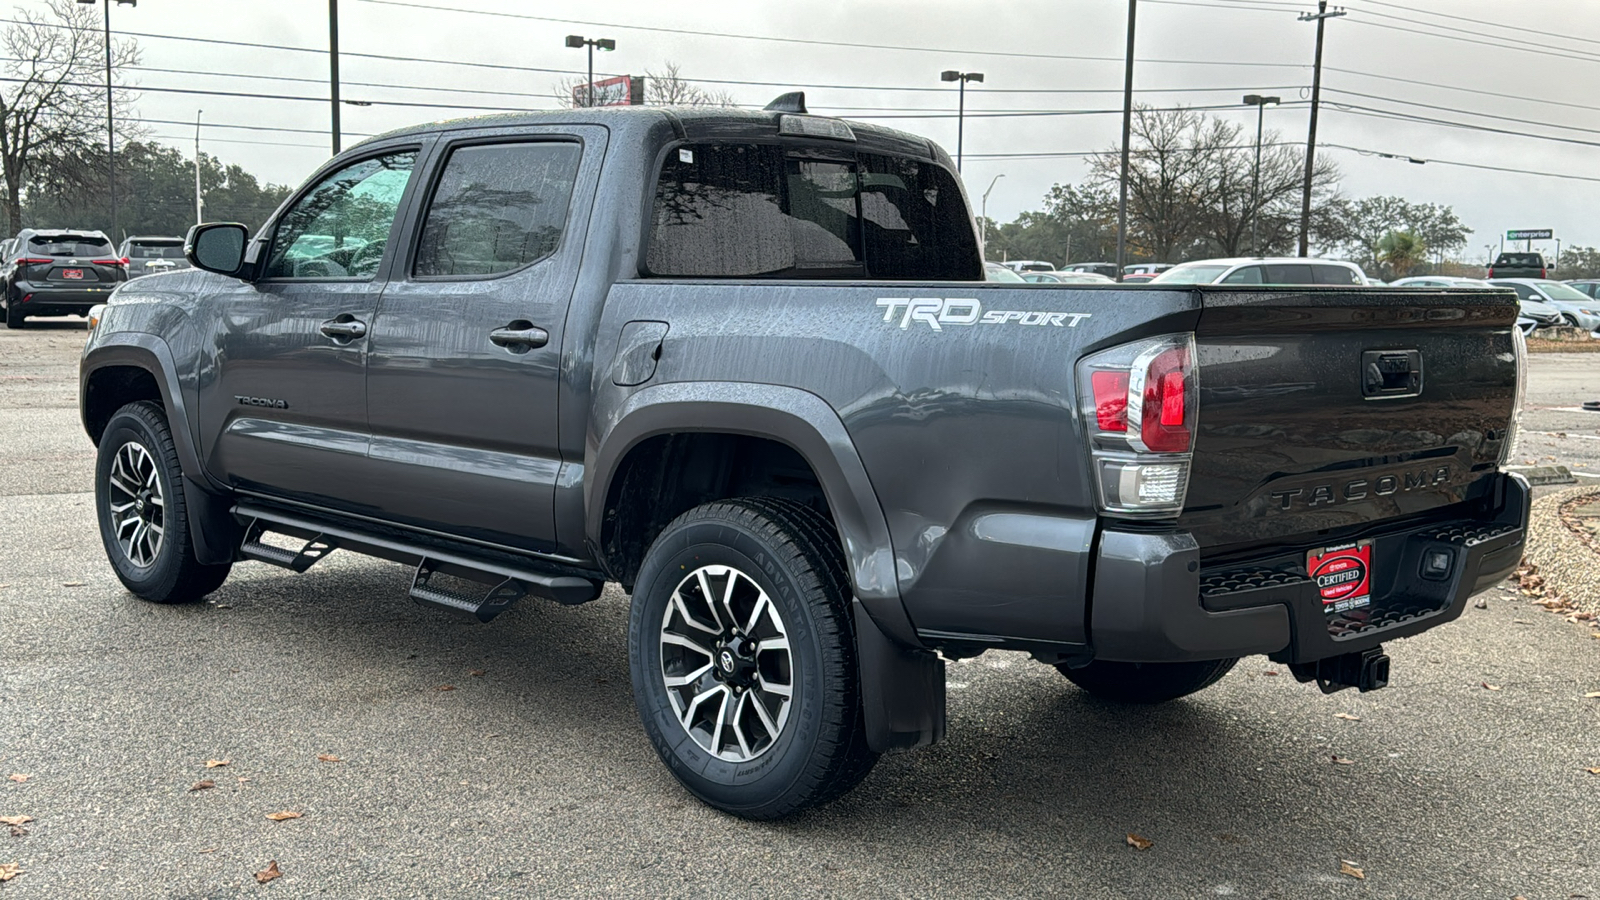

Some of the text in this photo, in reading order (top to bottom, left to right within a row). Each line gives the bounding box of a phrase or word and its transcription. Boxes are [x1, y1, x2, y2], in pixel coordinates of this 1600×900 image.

[1509, 230, 1551, 238] enterprise
[876, 297, 1092, 332] TRD SPORT
[234, 395, 288, 409] TACOMA
[1271, 466, 1451, 510] TACOMA
